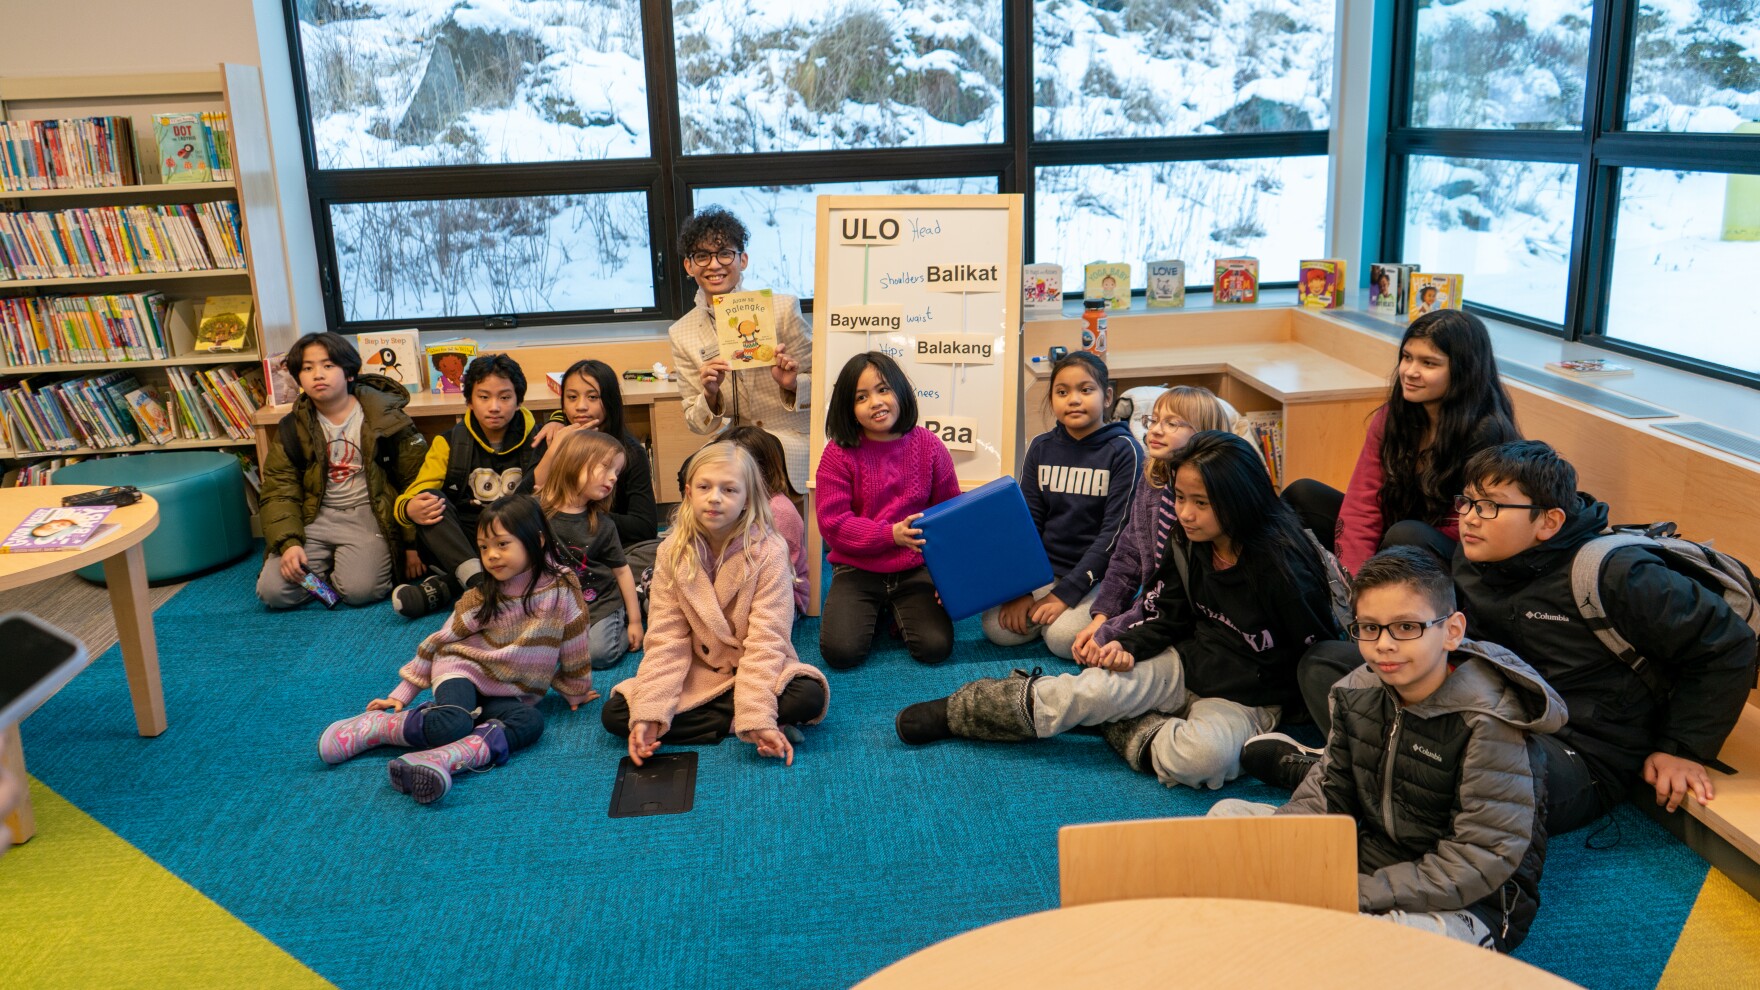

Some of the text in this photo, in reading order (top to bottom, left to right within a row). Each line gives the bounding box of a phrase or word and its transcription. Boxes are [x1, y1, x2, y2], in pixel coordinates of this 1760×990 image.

[842, 218, 900, 240] ULO
[908, 217, 942, 242] Head
[927, 264, 998, 283] Balikat
[1152, 266, 1178, 276] LOVE
[830, 313, 901, 330] Baywang
[906, 306, 933, 323] waist
[364, 337, 407, 346] Step by Step
[917, 341, 992, 358] Balakang
[913, 387, 940, 399] nees
[1038, 464, 1111, 497] PUMA
[1534, 611, 1570, 622] Columbia
[1418, 745, 1442, 762] Columbia
